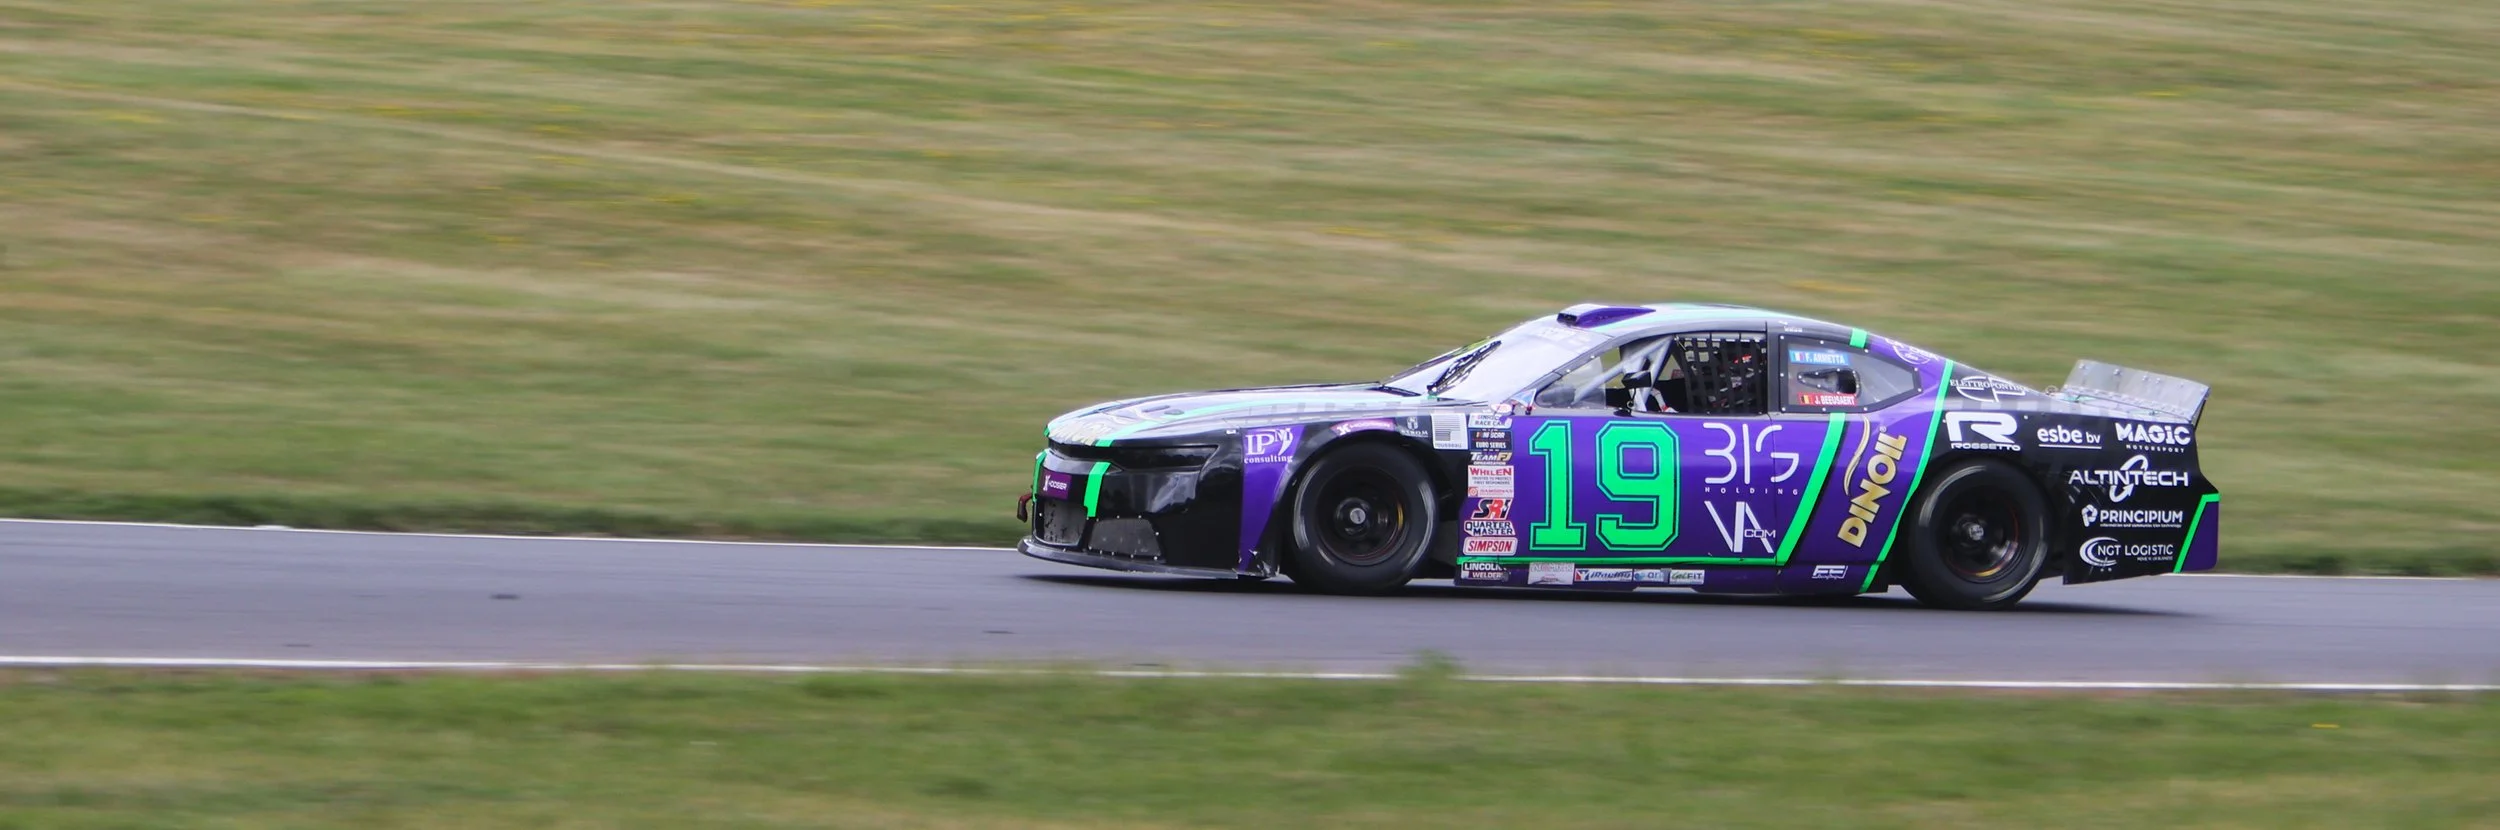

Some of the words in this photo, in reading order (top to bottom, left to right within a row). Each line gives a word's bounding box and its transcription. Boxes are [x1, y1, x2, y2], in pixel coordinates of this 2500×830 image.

[2037, 425, 2083, 443] esbe
[2086, 432, 2101, 444] bv
[1951, 443, 2021, 451] ROSSETTO
[1703, 422, 1799, 485] BIG
[1244, 455, 1293, 464] consulting
[2068, 470, 2189, 487] ALTINTECH
[1529, 420, 1680, 551] 19
[1705, 487, 1798, 495] HOLDING
[1837, 432, 1907, 548] DINOIL
[2100, 510, 2183, 523] PRINCIPIUM
[1465, 521, 1511, 531] QUARTER
[1744, 529, 1776, 538] COM
[1468, 540, 1512, 551] SIMPSON
[2097, 545, 2121, 556] NGT
[2125, 545, 2173, 556] LOGISTIC
